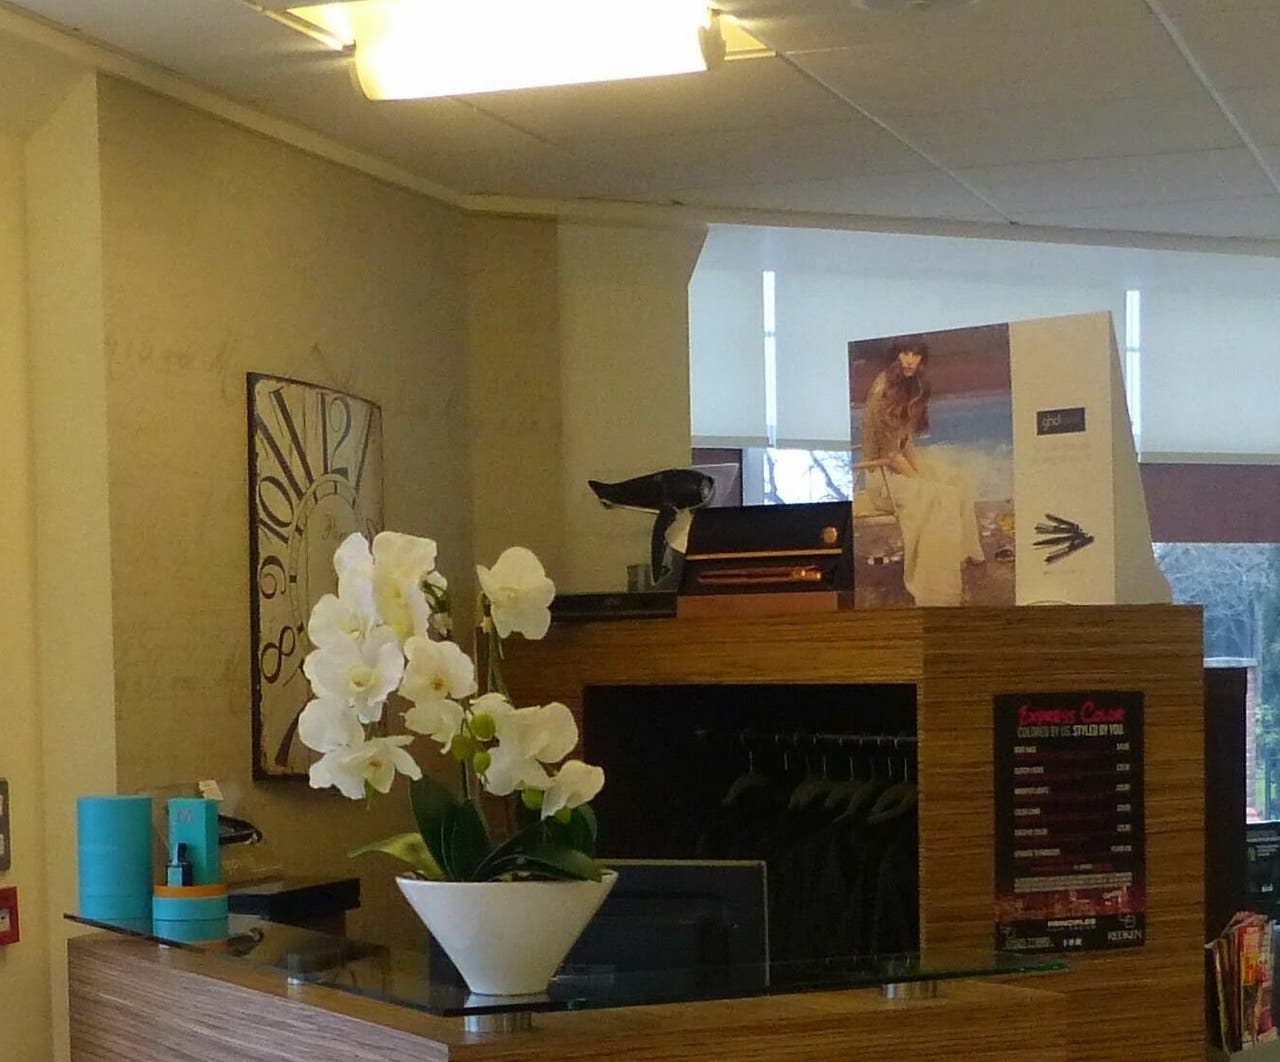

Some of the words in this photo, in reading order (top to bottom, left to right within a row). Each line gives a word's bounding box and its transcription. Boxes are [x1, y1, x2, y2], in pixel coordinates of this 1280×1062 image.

[317, 391, 352, 481] 12
[1041, 412, 1062, 432] ghd
[260, 624, 297, 684] 8
[1107, 929, 1142, 943] REDKEN
